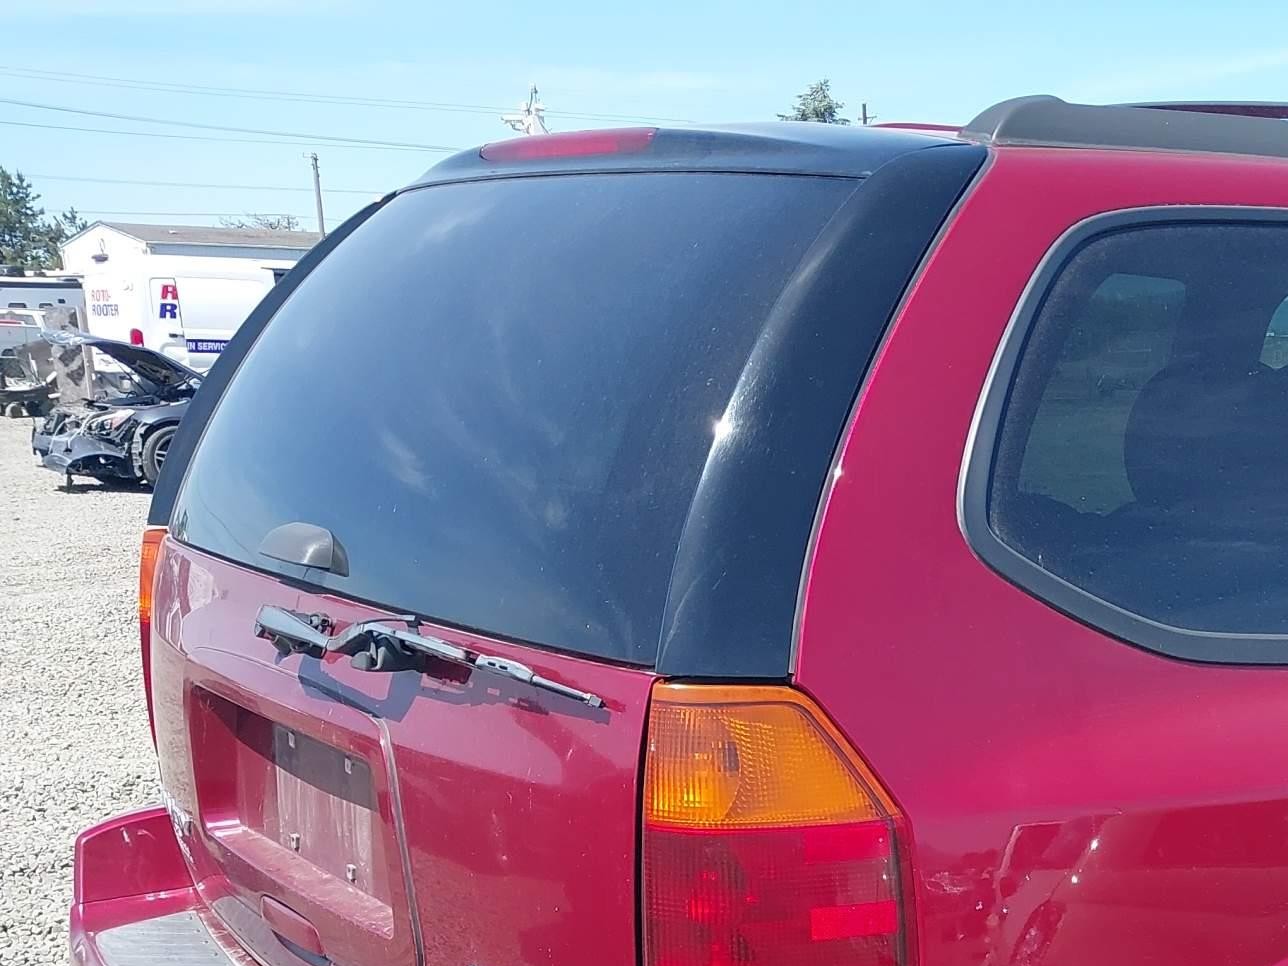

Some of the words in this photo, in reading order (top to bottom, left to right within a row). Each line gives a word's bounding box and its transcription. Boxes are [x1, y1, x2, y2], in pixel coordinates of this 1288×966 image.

[161, 284, 179, 300] R
[92, 303, 120, 317] ROOTER
[159, 302, 178, 319] R
